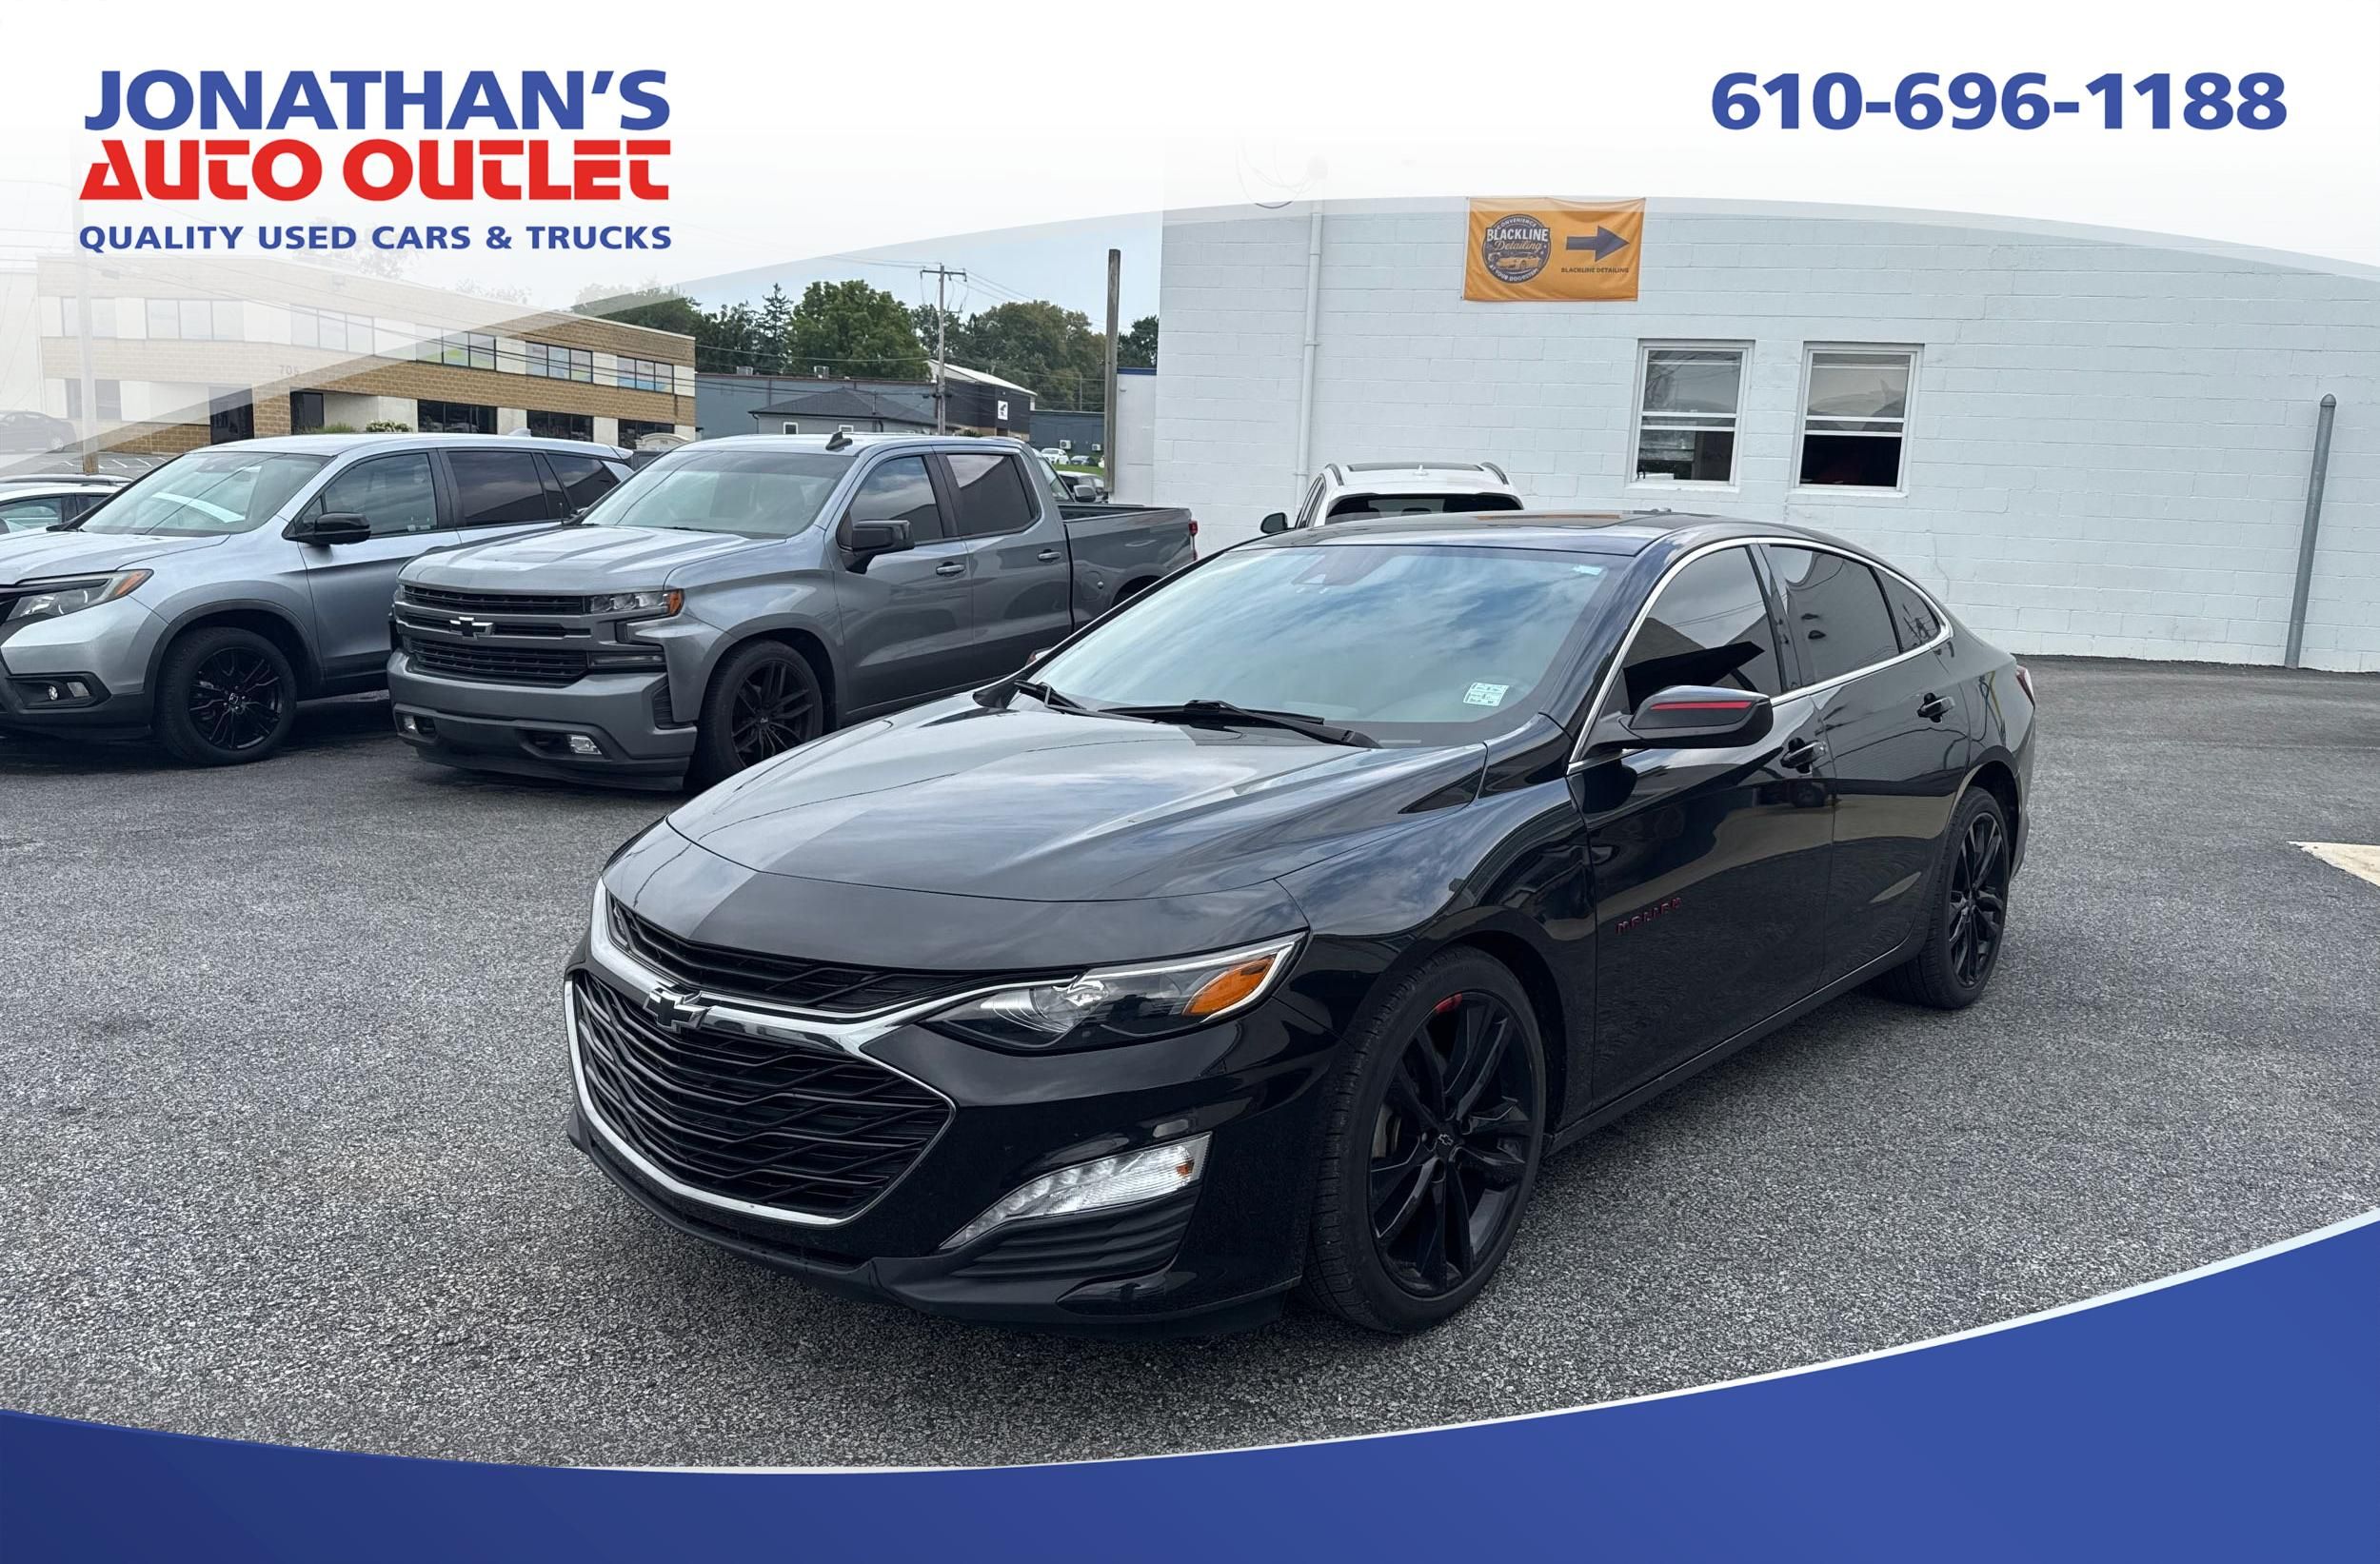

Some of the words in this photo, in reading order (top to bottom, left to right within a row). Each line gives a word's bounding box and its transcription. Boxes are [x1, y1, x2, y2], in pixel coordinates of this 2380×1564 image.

[1497, 218, 1537, 230] CONVENIENCE
[1487, 228, 1549, 242] BLACKLINE
[1493, 240, 1542, 252] Detailing
